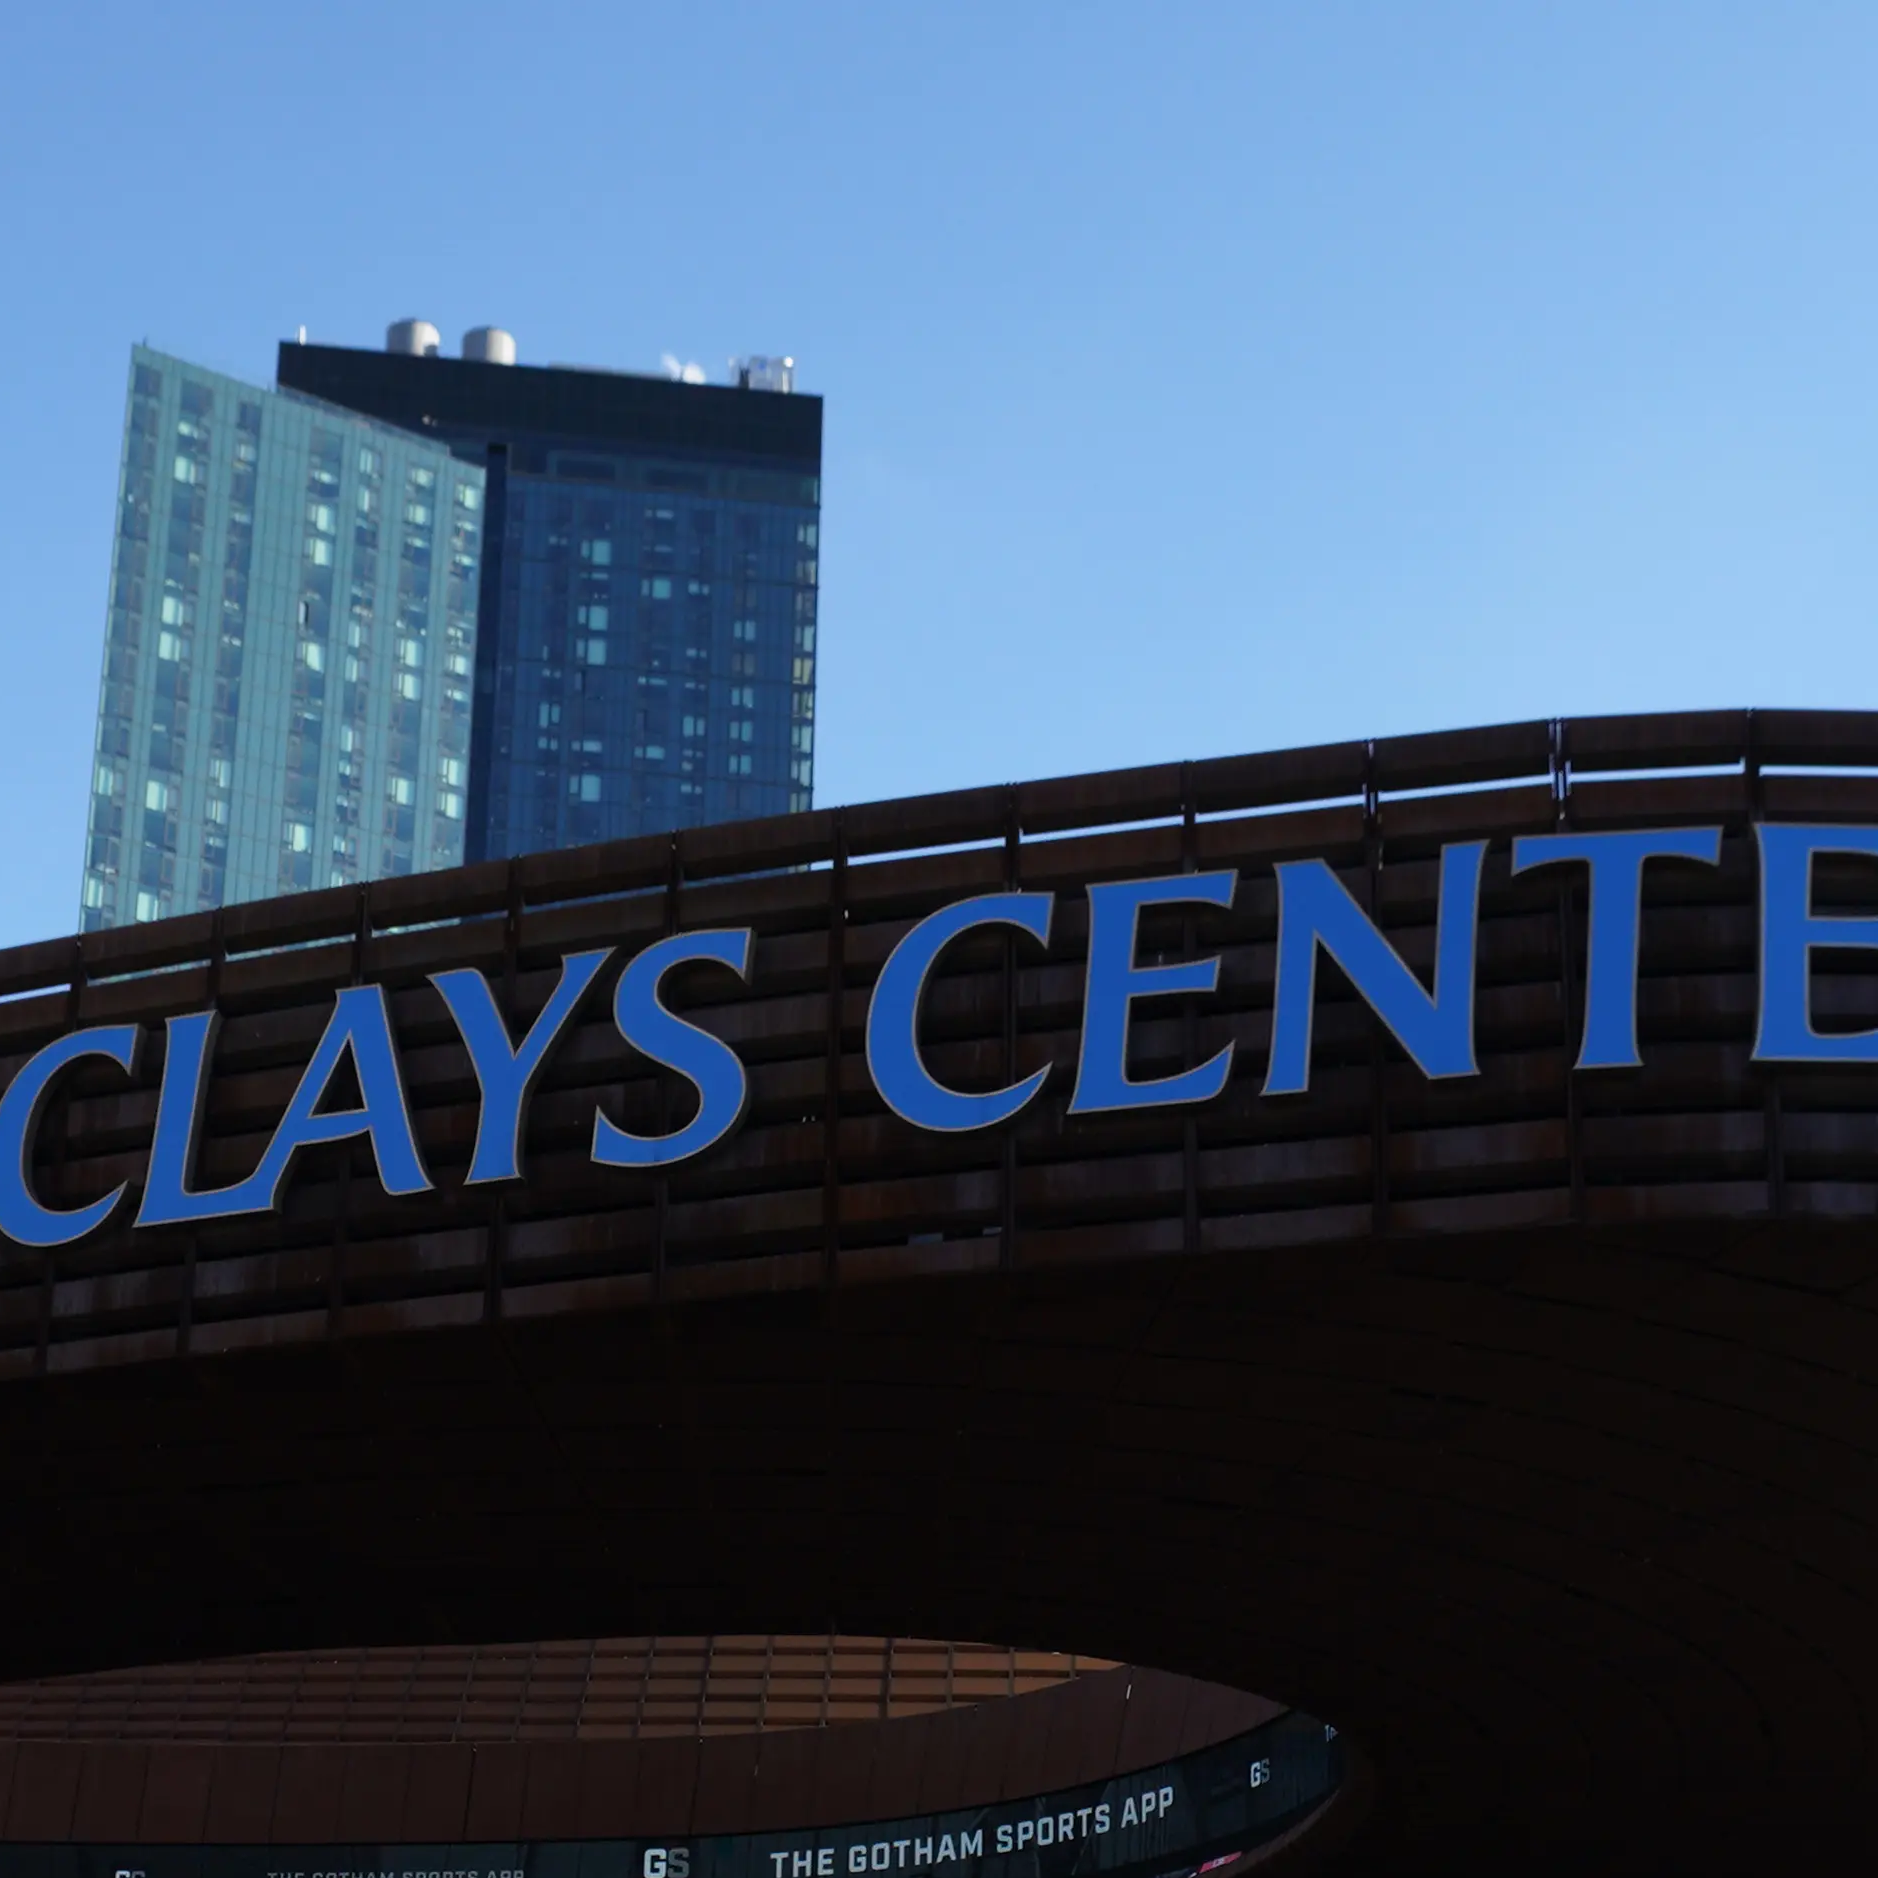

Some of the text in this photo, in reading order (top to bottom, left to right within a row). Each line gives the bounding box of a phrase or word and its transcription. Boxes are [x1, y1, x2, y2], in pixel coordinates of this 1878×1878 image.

[848, 1829, 984, 1873] GOTHAM
[996, 1803, 1111, 1854] SPORTS
[1120, 1786, 1174, 1828] APP
